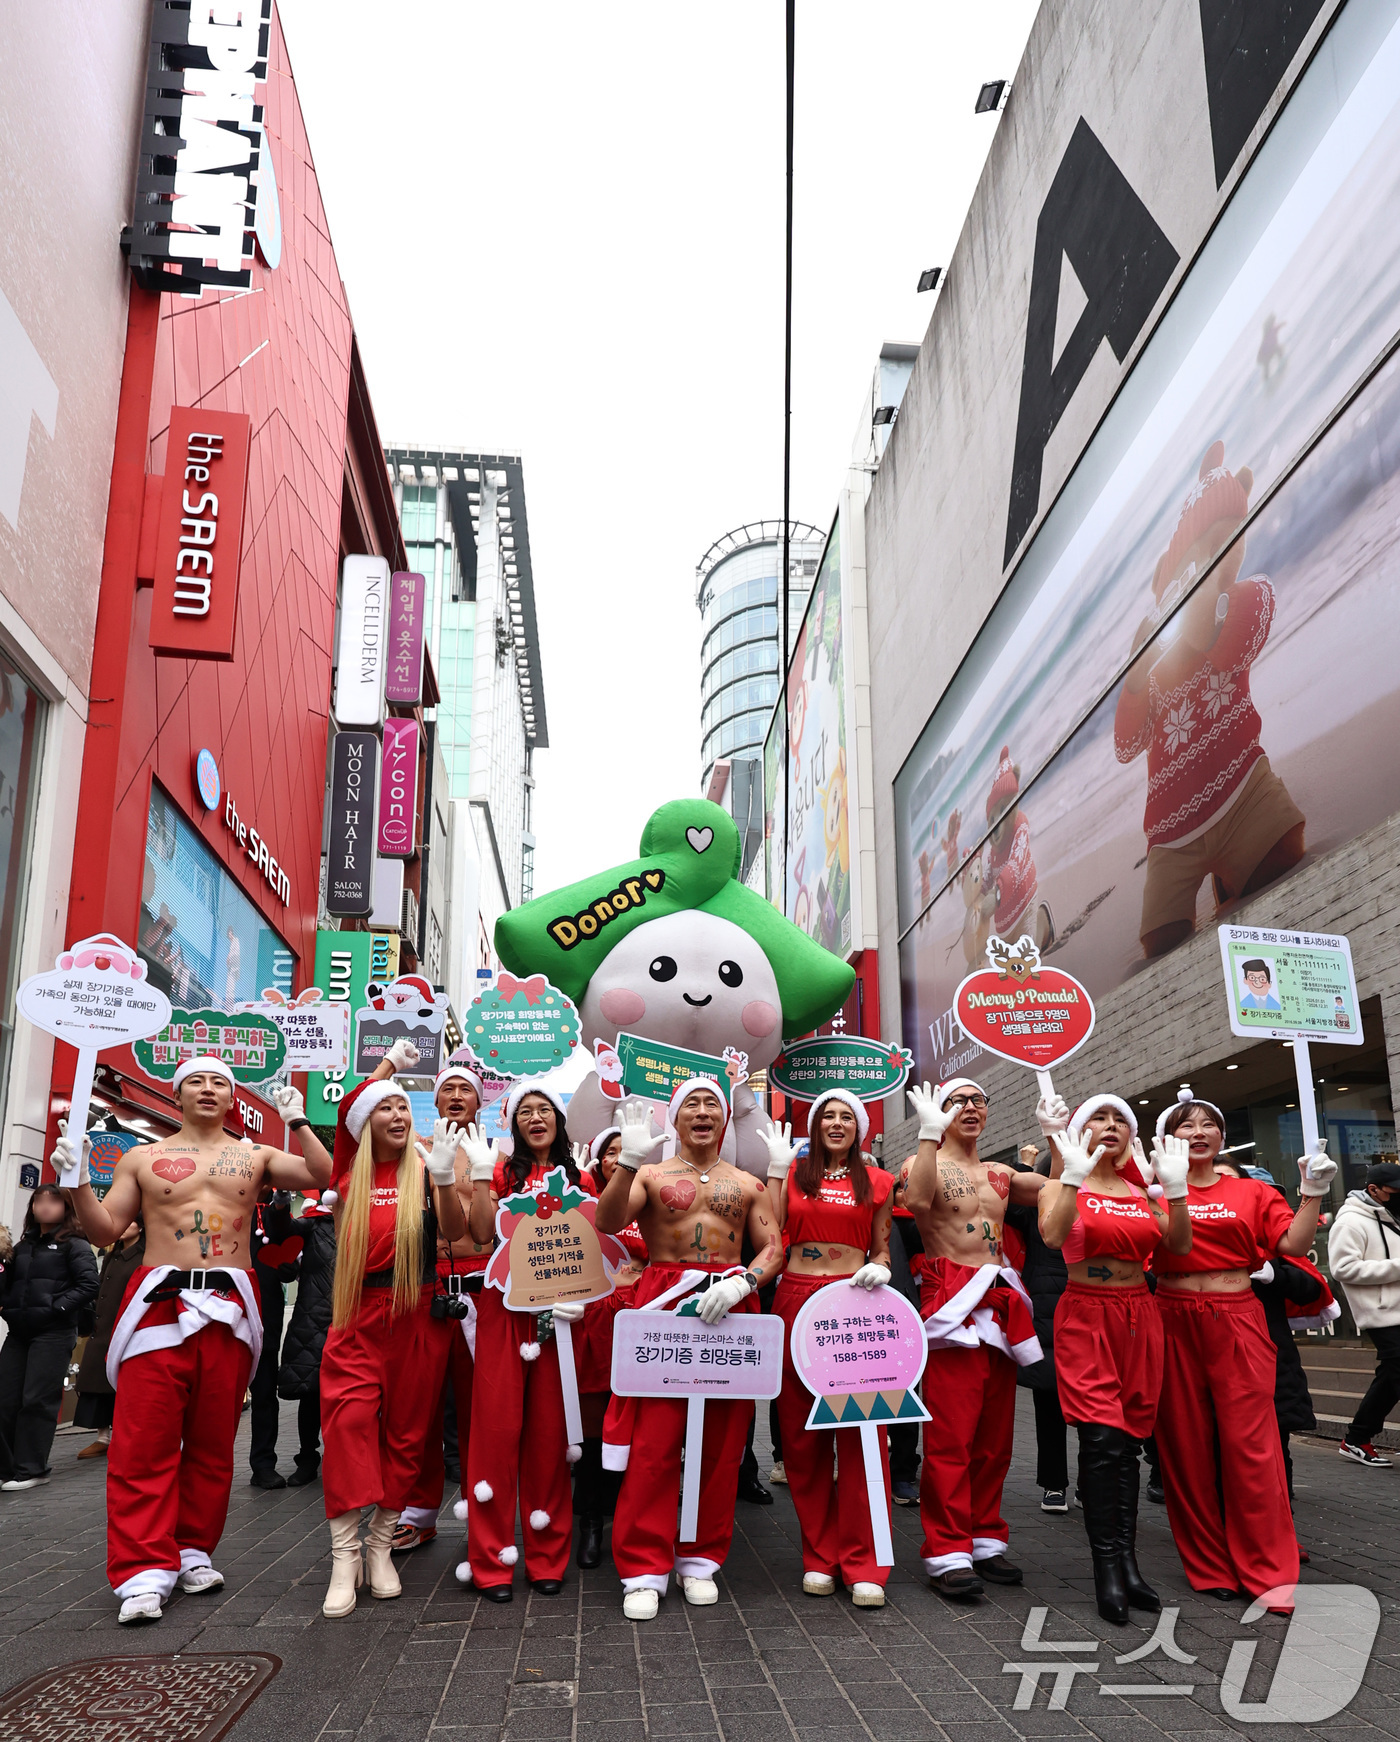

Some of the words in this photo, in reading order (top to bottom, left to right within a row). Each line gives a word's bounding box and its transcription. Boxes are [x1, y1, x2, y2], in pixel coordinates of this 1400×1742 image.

[185, 432, 223, 482] the
[172, 489, 218, 616] SAEM
[398, 580, 416, 626] 제일사
[360, 576, 381, 683] INCELLDERM
[394, 630, 414, 682] 옷수선
[346, 743, 363, 802] MOON
[343, 811, 360, 870] HAIR
[225, 791, 247, 848] the
[248, 827, 291, 908] SAEM
[334, 881, 362, 890] SALON
[333, 891, 363, 899] 752-0368
[549, 877, 644, 949] Donor
[1229, 929, 1259, 941] 장기기증
[1262, 932, 1277, 942] 희망
[1280, 934, 1301, 945] 의사를
[1303, 936, 1340, 948] 표시하세요!
[1276, 958, 1289, 966] 서울
[63, 979, 83, 990] 실제
[86, 982, 134, 997] 장기기증은
[35, 988, 66, 1000] 가족의
[70, 992, 100, 1004] 동의가
[103, 997, 123, 1008] 있을
[126, 1000, 157, 1012] 때에만
[967, 991, 1016, 1010] Merry
[1016, 991, 1025, 1004] 9
[1025, 988, 1079, 1004] Parade!
[73, 1005, 116, 1019] 가능해요!
[287, 1015, 317, 1025] 따뜻한
[480, 1010, 515, 1021] 장기기증
[518, 1009, 561, 1020] 희망등록은
[985, 1009, 1045, 1024] 장기기증으로
[1045, 1009, 1071, 1021] 9명의
[305, 1026, 328, 1038] 선물,
[495, 1022, 529, 1032] 구속력이
[532, 1021, 550, 1031] 없는
[1001, 1023, 1031, 1036] 생명을
[1032, 1022, 1064, 1034] 살려요!
[223, 1027, 276, 1048] 장식하는
[289, 1038, 333, 1049] 희망등록!
[154, 1045, 192, 1063] 빛나는
[791, 1056, 827, 1067] 장기기증
[829, 1056, 883, 1067] 희망등록으로
[636, 1056, 671, 1073] 생명나눔
[788, 1069, 816, 1080] 성탄의
[818, 1069, 846, 1080] 기적을
[848, 1069, 887, 1080] 전하세요!
[25, 1175, 35, 1187] 39
[1101, 1199, 1137, 1211] Merry
[1105, 1207, 1151, 1219] Parade
[534, 1223, 571, 1237] 장기기증
[527, 1236, 582, 1252] 희망등록으로
[527, 1253, 555, 1267] 성탄의
[558, 1250, 585, 1262] 기적을
[533, 1264, 582, 1281] 선물하세요!
[813, 1319, 839, 1331] 9명을
[842, 1316, 872, 1328] 구하는
[875, 1314, 898, 1325] 약속,
[643, 1332, 661, 1342] 가장
[663, 1333, 690, 1343] 따뜻한
[692, 1334, 734, 1345] 크리스마스
[736, 1335, 755, 1346] 선물,
[815, 1333, 854, 1347] 장기기증
[857, 1329, 900, 1343] 희망등록!
[635, 1346, 693, 1365] 장기기증
[699, 1348, 761, 1366] 희망등록!
[833, 1349, 887, 1363] 1588-1589
